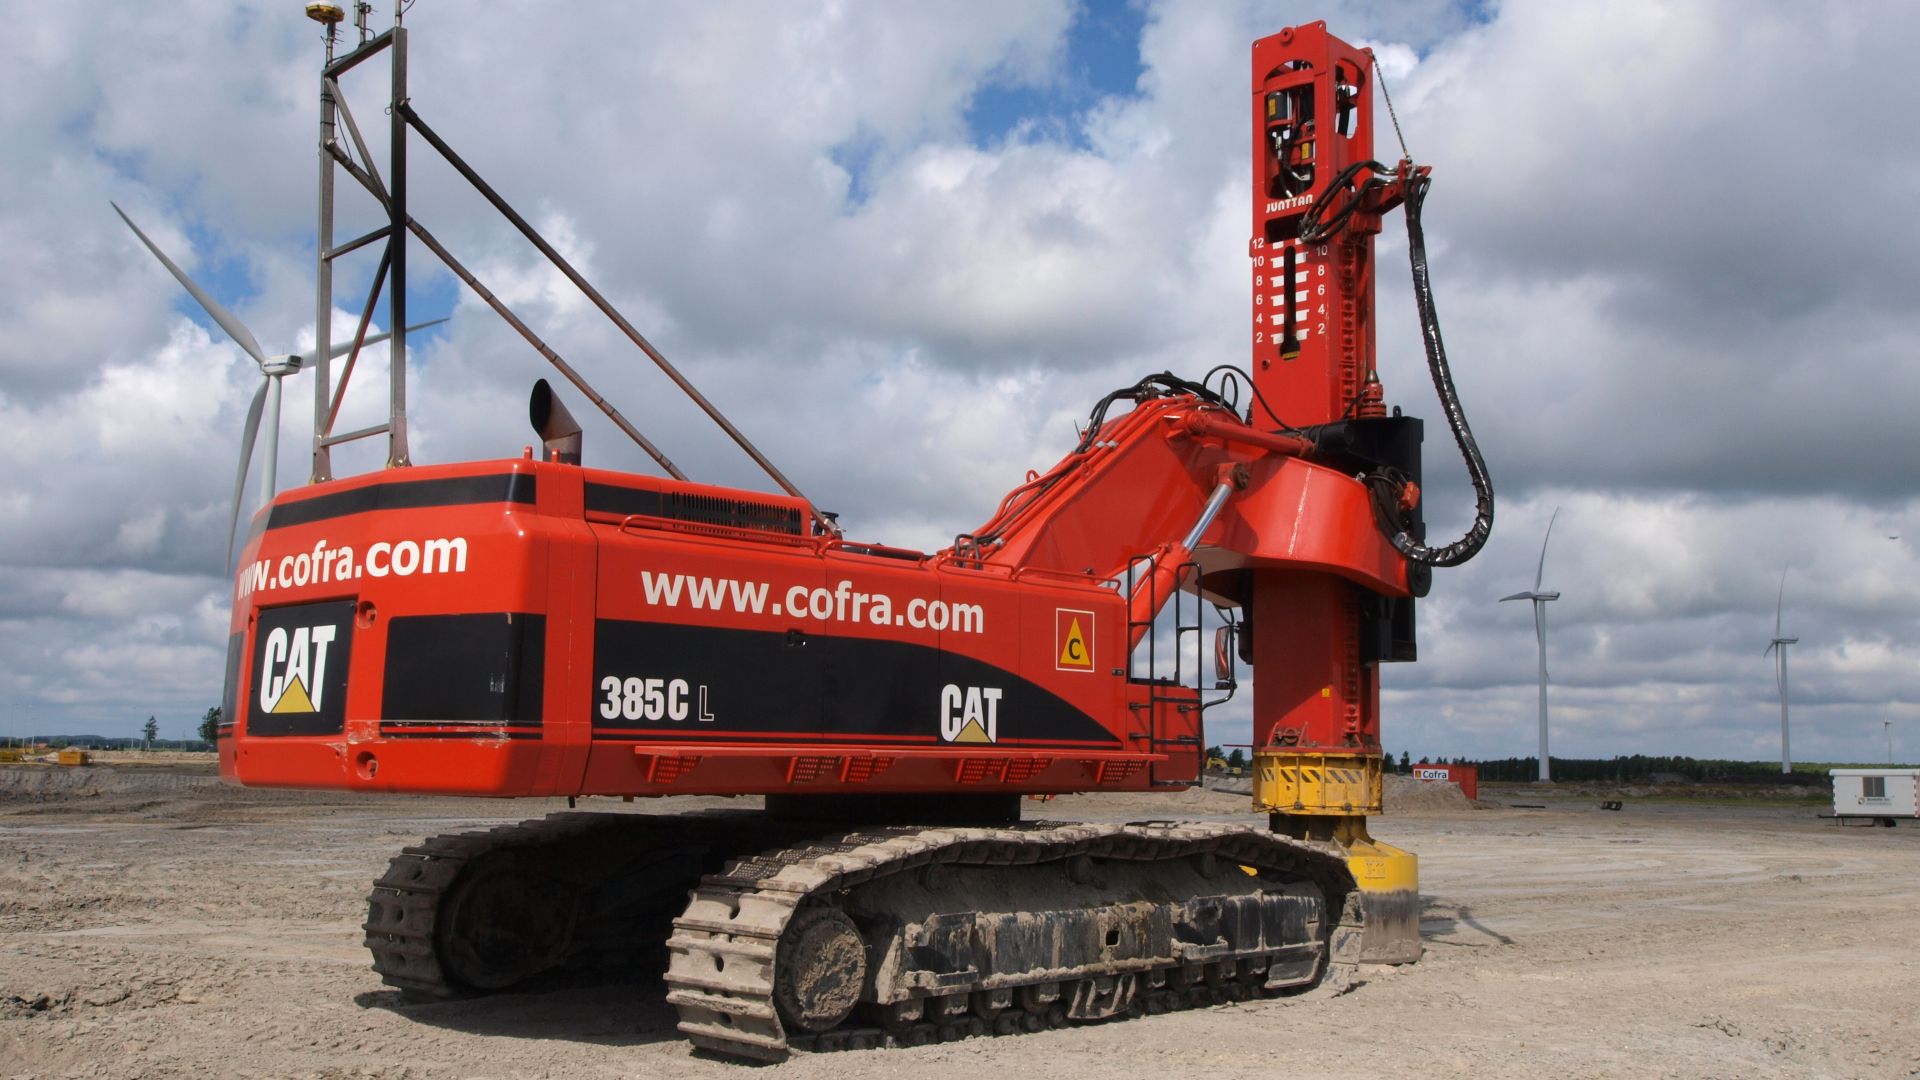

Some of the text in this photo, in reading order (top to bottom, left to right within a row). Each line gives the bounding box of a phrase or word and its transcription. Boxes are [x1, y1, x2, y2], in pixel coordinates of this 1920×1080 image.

[1265, 194, 1313, 213] JUNTTAN
[1253, 237, 1264, 250] 12
[1316, 245, 1328, 257] 10
[1253, 256, 1264, 268] 10
[1317, 264, 1325, 277] 8
[1256, 275, 1263, 287] 8
[1317, 284, 1325, 296] 6
[1256, 294, 1263, 306] 6
[1317, 303, 1326, 315] 4
[1256, 313, 1263, 325] 4
[1317, 323, 1325, 335] 2
[1256, 332, 1263, 344] 2
[238, 537, 467, 600] www.cofra.com
[641, 571, 984, 634] www.cofra.com
[1069, 638, 1080, 660] C
[260, 625, 336, 714] CAT
[600, 676, 715, 722] 385C L
[941, 684, 1002, 743] CAT
[1423, 770, 1447, 779] Cofra
